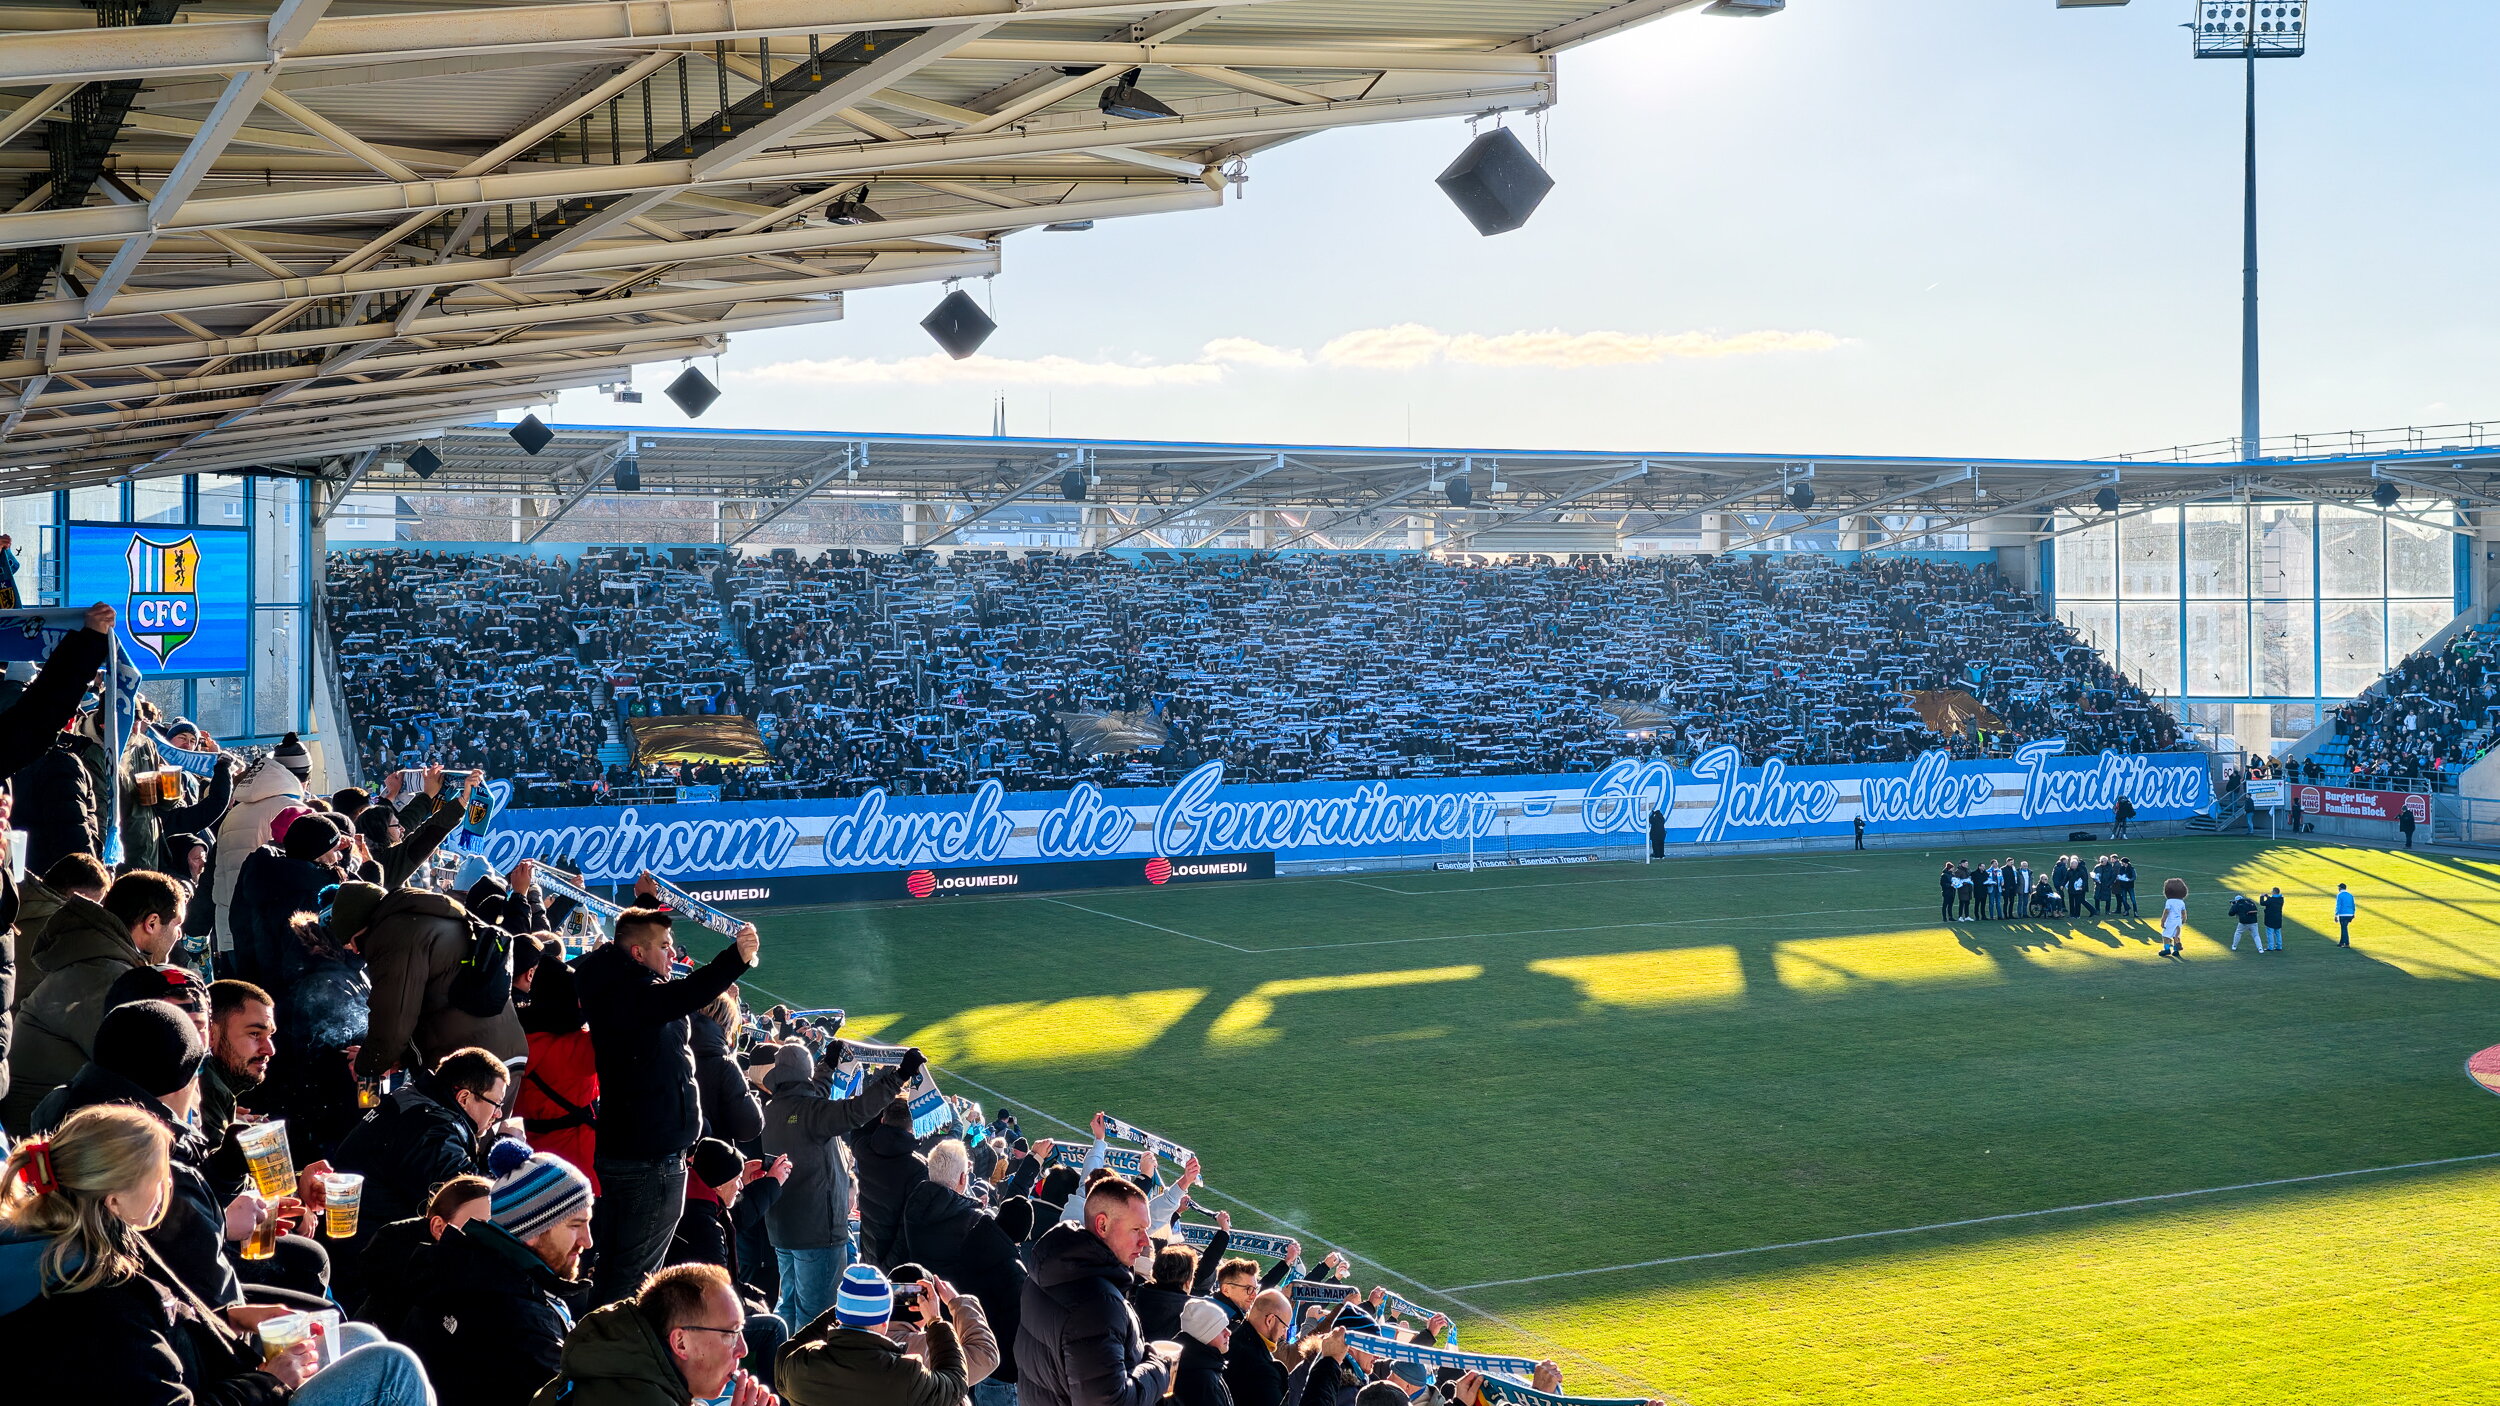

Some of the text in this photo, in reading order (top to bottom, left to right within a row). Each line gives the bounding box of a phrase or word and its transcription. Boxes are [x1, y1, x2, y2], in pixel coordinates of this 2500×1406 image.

[137, 600, 187, 628] CFC
[2302, 800, 2319, 809] KING
[2325, 791, 2377, 806] Burger King
[823, 777, 1015, 868] durch
[1037, 780, 1137, 858] die
[1152, 758, 1497, 858] Generationen
[1582, 757, 1676, 835] 60
[1691, 744, 1841, 841] Jahre
[1860, 749, 1993, 823] voller
[2325, 803, 2387, 817] Familien Block
[1518, 856, 1558, 866] Eisenbach
